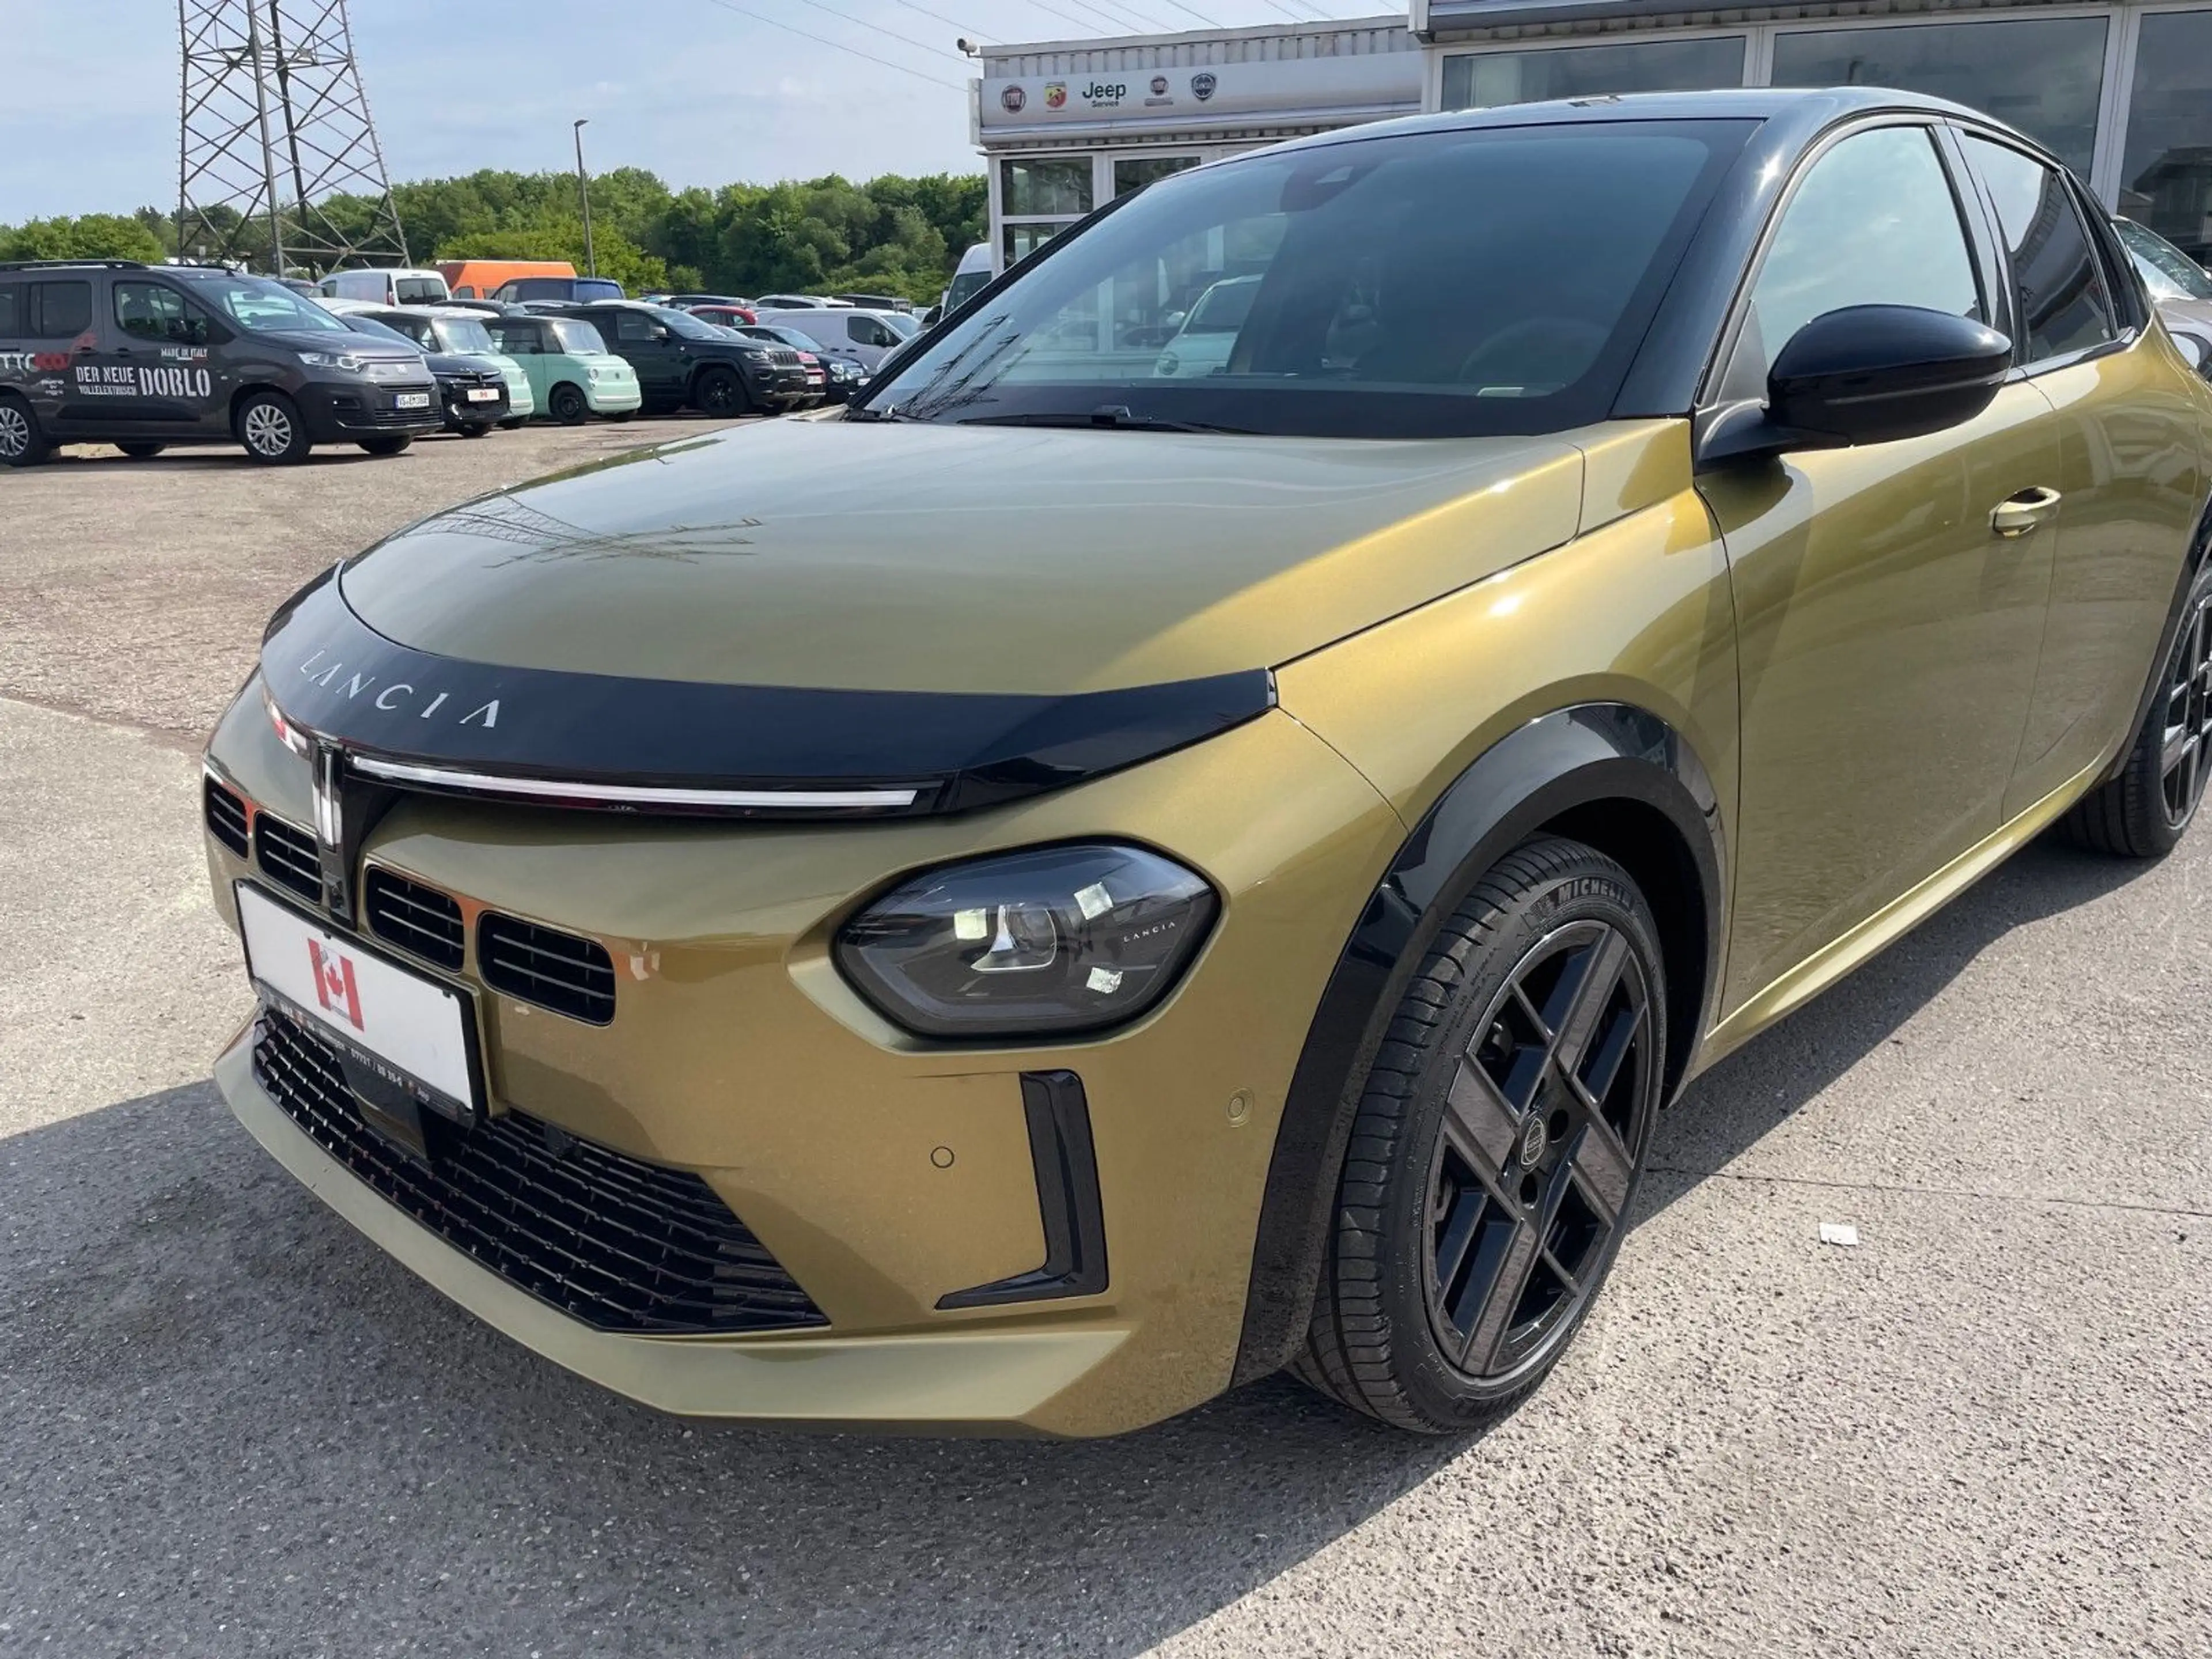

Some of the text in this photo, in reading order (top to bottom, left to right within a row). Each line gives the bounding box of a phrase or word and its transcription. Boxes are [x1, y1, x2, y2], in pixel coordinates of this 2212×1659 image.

[1082, 82, 1126, 100] Jeep
[191, 348, 208, 357] ITALY
[76, 366, 135, 383] DER NEUE
[138, 368, 211, 397] DOBLO
[300, 650, 500, 728] LANCIA
[1558, 877, 1635, 909] MICHELIN
[1123, 922, 1175, 942] LANCIA
